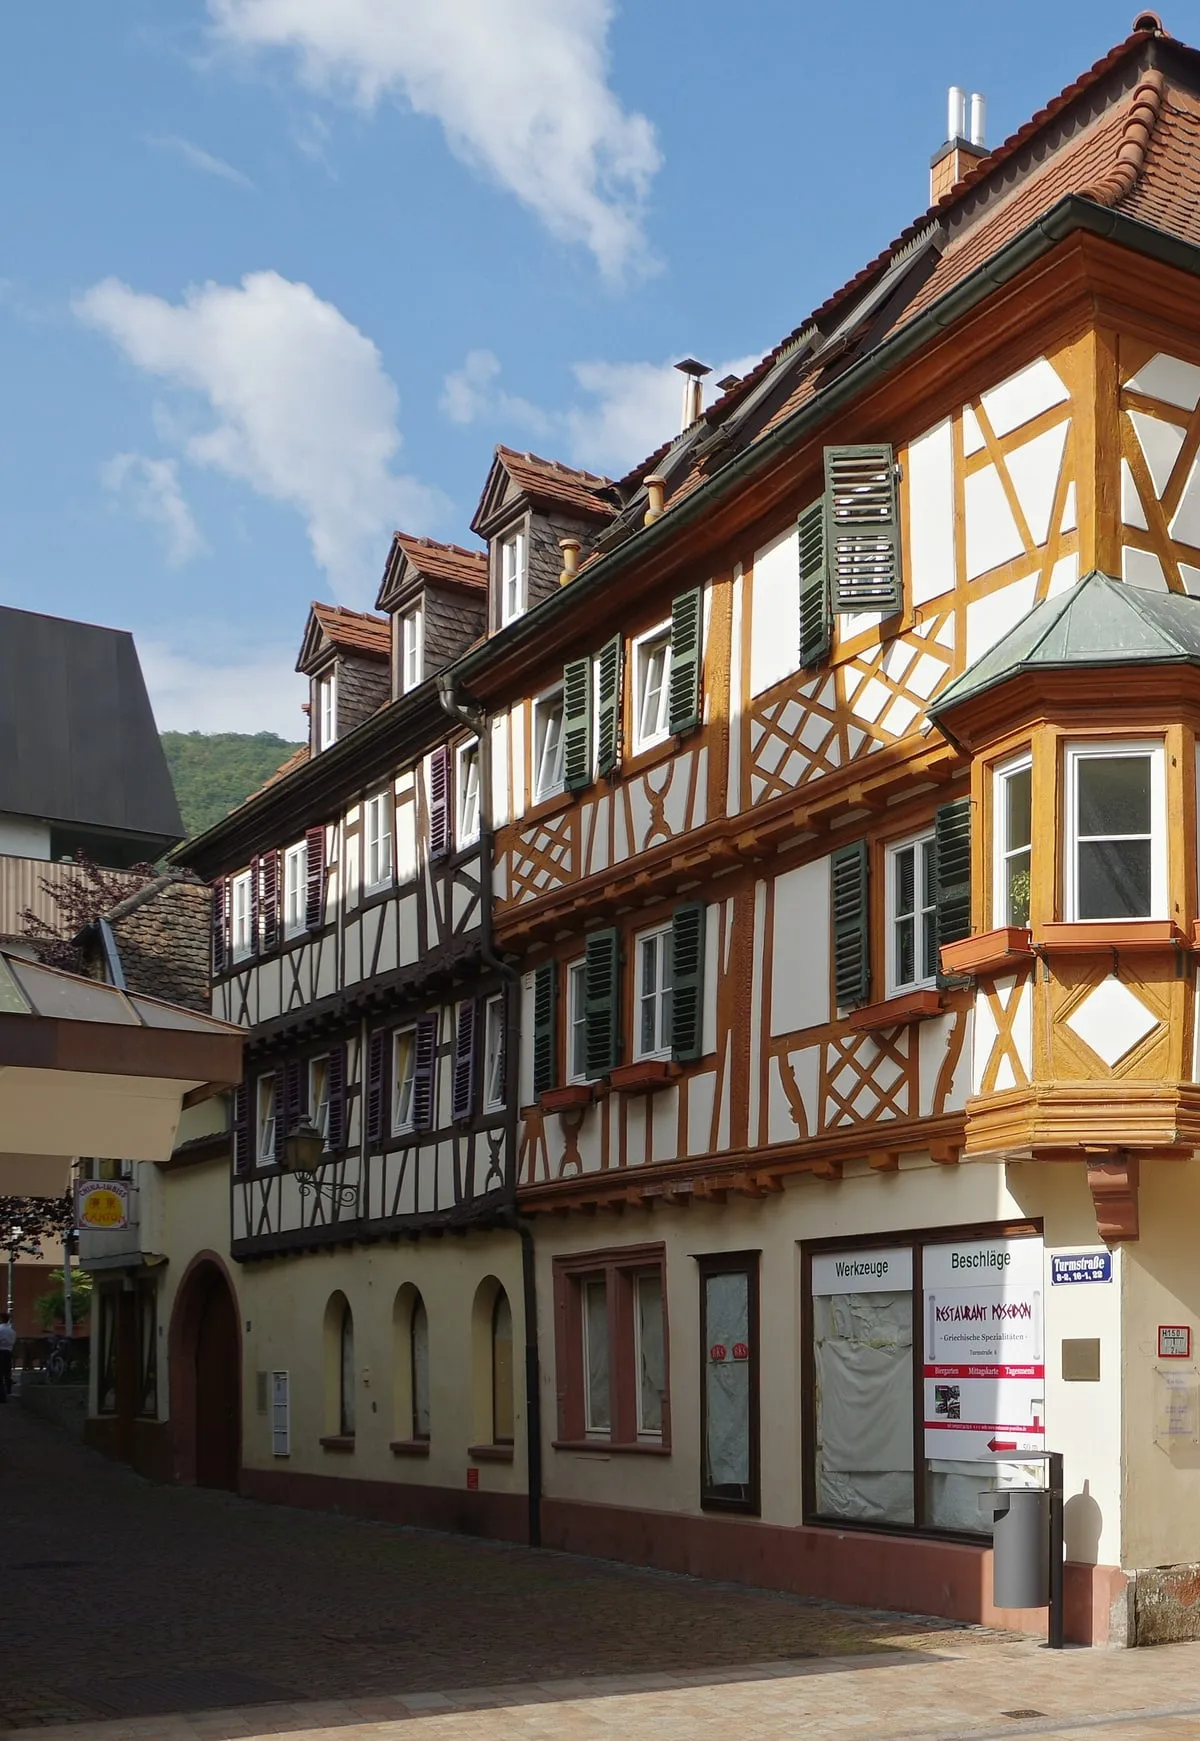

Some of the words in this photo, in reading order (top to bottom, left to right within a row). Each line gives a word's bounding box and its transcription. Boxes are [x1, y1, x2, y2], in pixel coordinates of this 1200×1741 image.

[835, 1260, 889, 1278] Werkzeuge
[952, 1250, 1011, 1270] Beschläge
[1054, 1255, 1105, 1272] Turmstraße
[936, 1303, 988, 1322] RESTAURANT
[992, 1301, 1031, 1320] POSEIDON
[981, 1333, 1024, 1342] Spezialitäten
